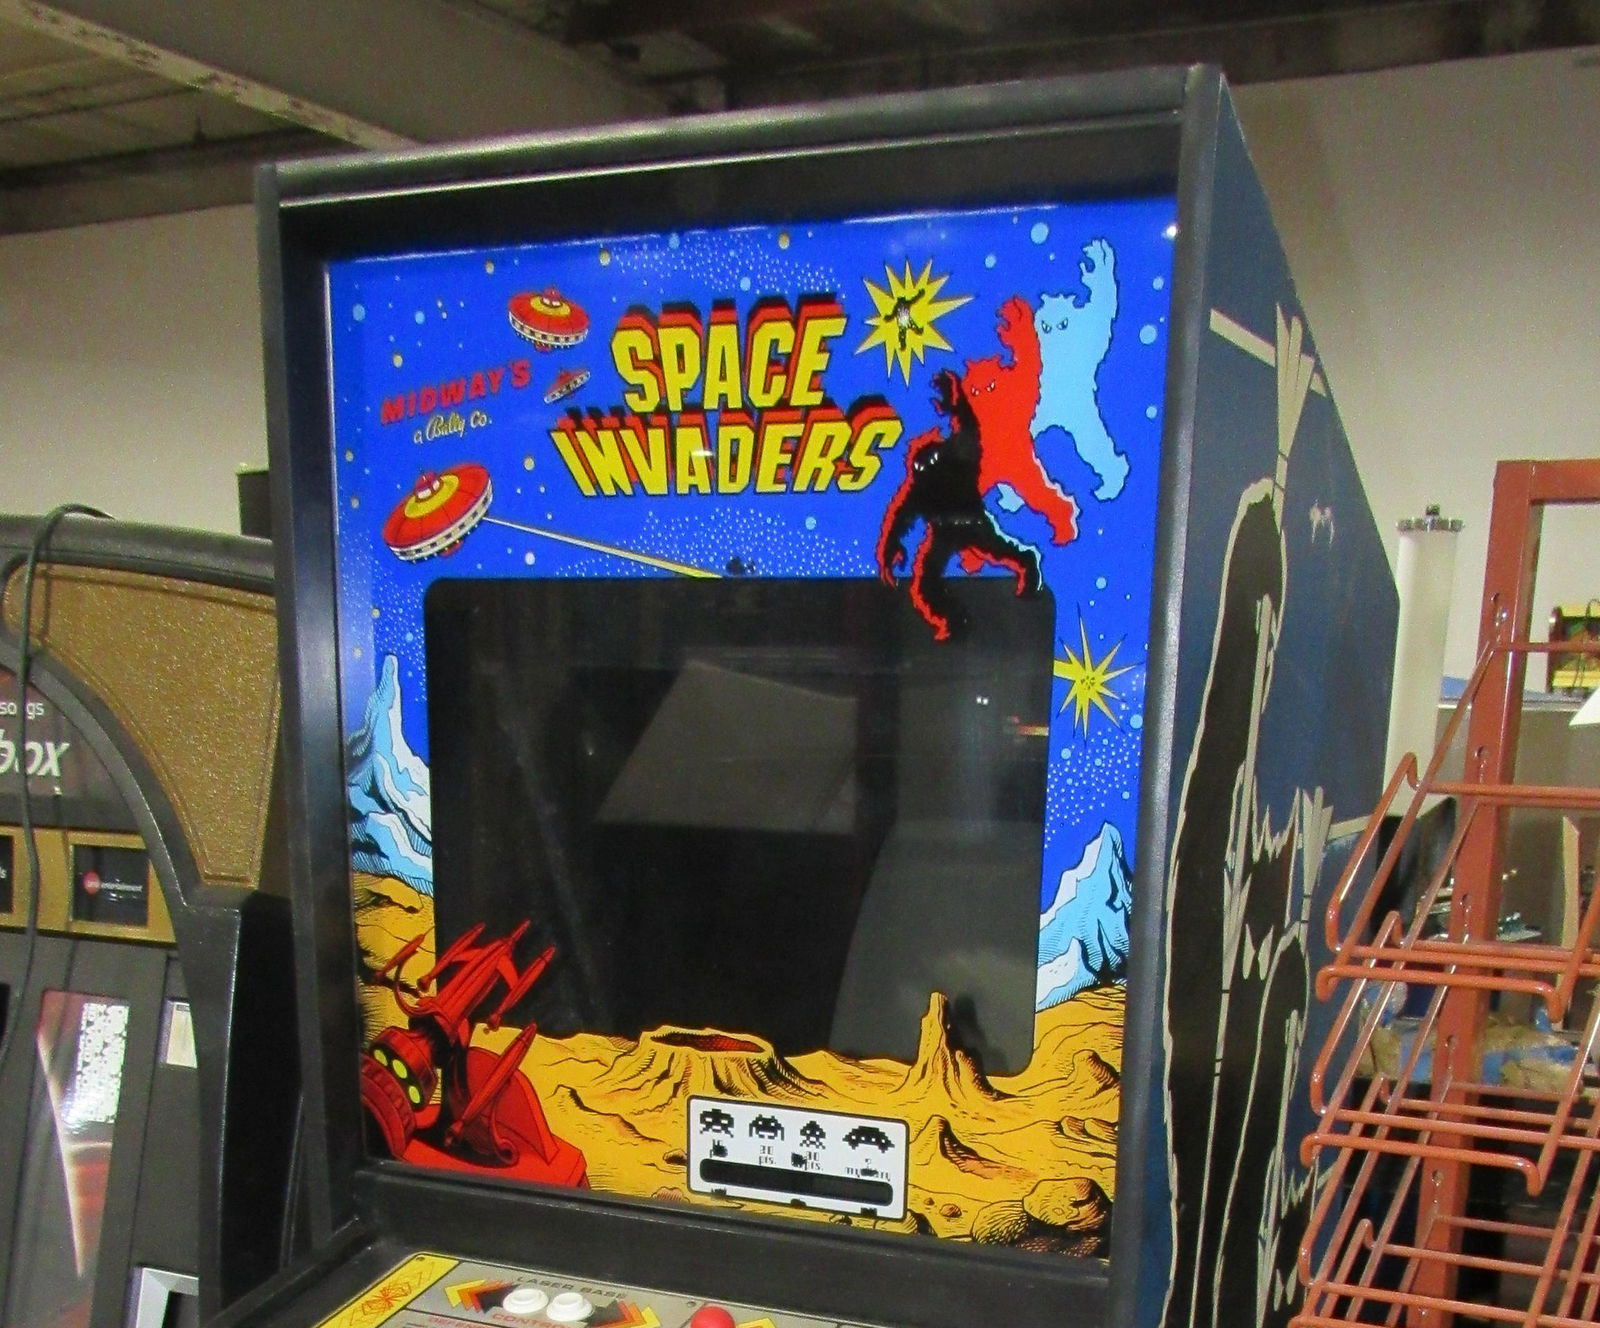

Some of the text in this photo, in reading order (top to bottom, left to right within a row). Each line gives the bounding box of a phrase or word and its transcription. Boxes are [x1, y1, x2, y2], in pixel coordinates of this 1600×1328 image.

[611, 310, 847, 413] SPACE
[380, 359, 531, 425] MIDWAY'S
[413, 410, 493, 444] a Bally Co.
[549, 418, 904, 497] INVADERS
[0, 702, 45, 720] sogs
[517, 1276, 627, 1299] LASER BASE
